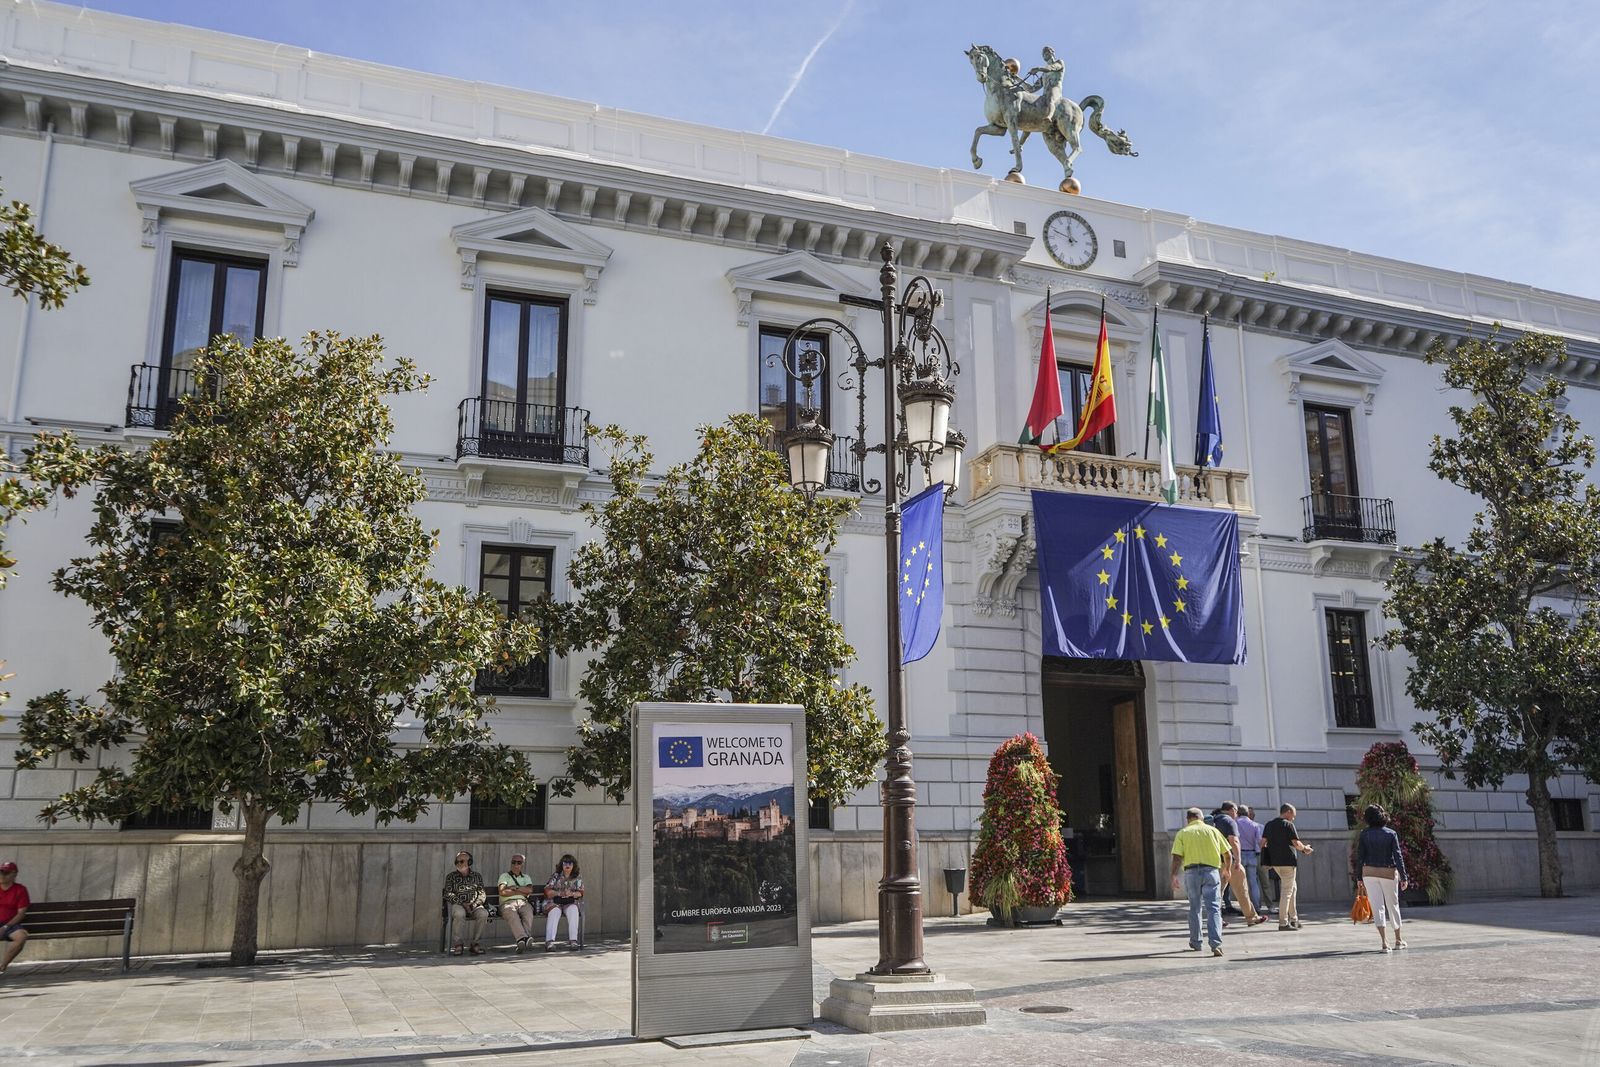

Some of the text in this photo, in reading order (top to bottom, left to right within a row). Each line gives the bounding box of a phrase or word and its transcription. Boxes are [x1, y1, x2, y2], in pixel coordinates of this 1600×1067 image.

[706, 737, 783, 748] WELCOME TO
[707, 751, 784, 766] GRANADA
[671, 904, 782, 918] CUMBRE EUROPEA GRANADA 2023
